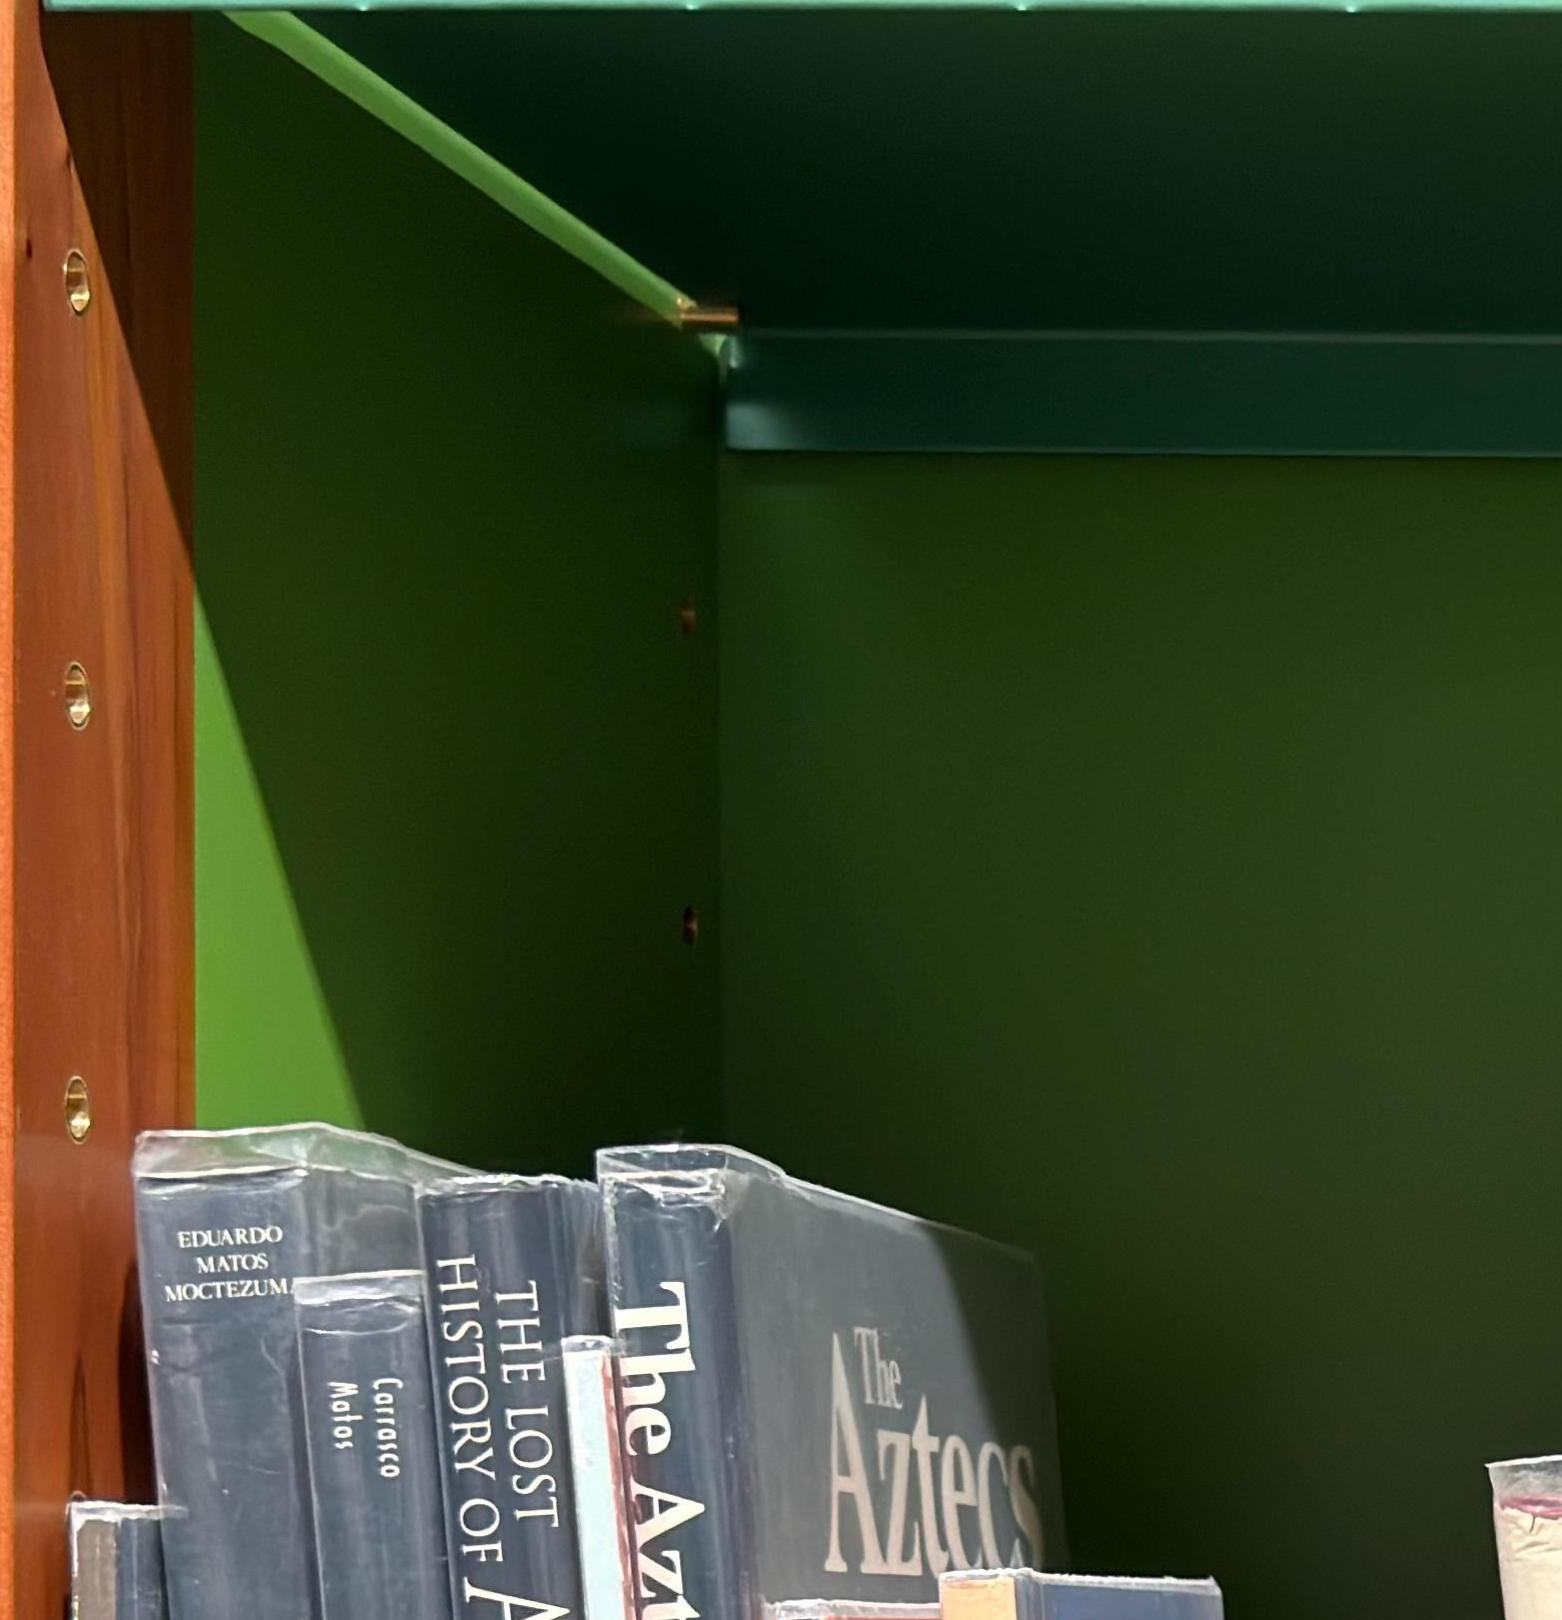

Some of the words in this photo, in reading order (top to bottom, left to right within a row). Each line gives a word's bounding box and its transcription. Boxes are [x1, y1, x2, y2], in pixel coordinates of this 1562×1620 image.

[177, 1226, 283, 1250] EDUARDO
[197, 1252, 269, 1274] MATOS
[437, 1254, 497, 1478] HISTORY
[495, 1281, 545, 1385] THE
[614, 1281, 696, 1456] The
[329, 1382, 354, 1451] Matos
[370, 1377, 403, 1479] Carrasco
[505, 1403, 561, 1528] LOST
[457, 1502, 504, 1563] OF
